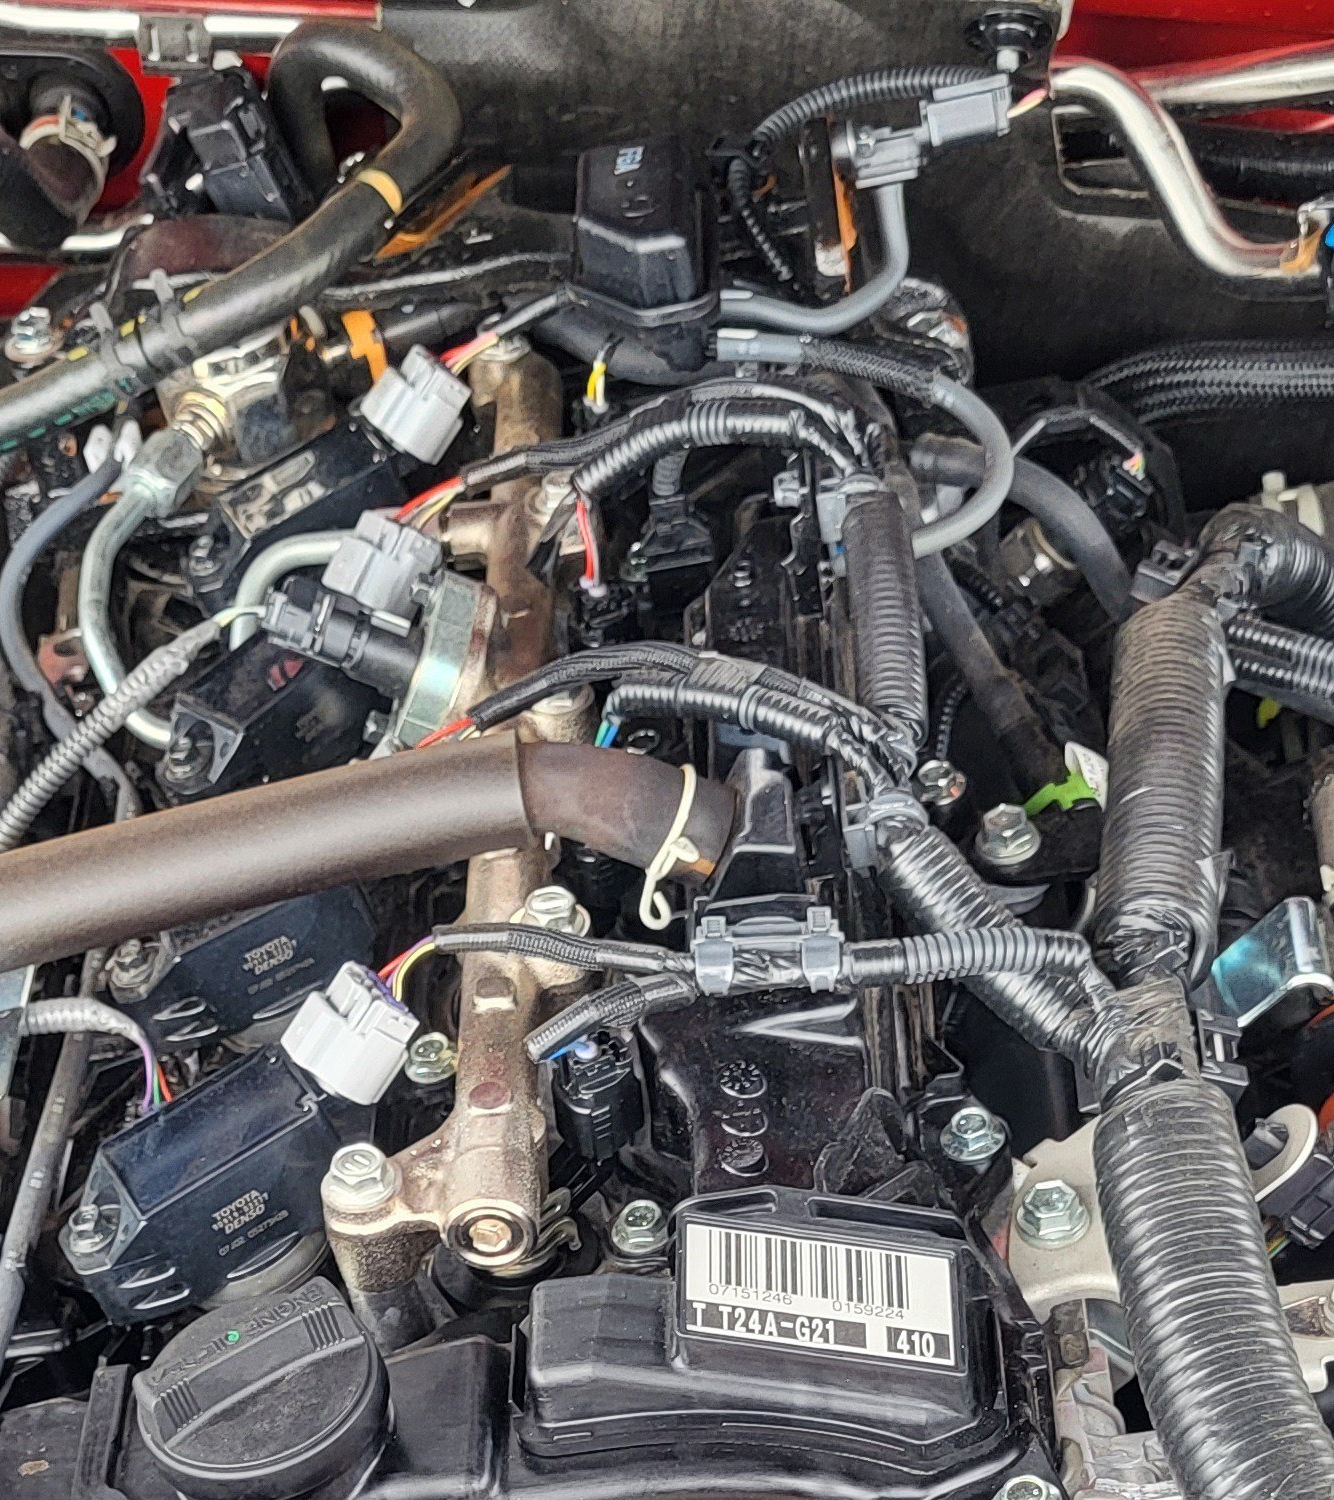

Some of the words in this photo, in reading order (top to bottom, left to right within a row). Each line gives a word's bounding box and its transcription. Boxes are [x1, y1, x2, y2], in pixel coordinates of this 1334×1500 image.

[211, 1189, 264, 1221] TOYOTA
[224, 1203, 266, 1234] DENSO
[708, 1283, 793, 1306] 07151246
[832, 1300, 905, 1320] 0159224
[692, 1302, 706, 1327] T
[718, 1305, 835, 1345] T24A-G21
[896, 1330, 935, 1358] 410
